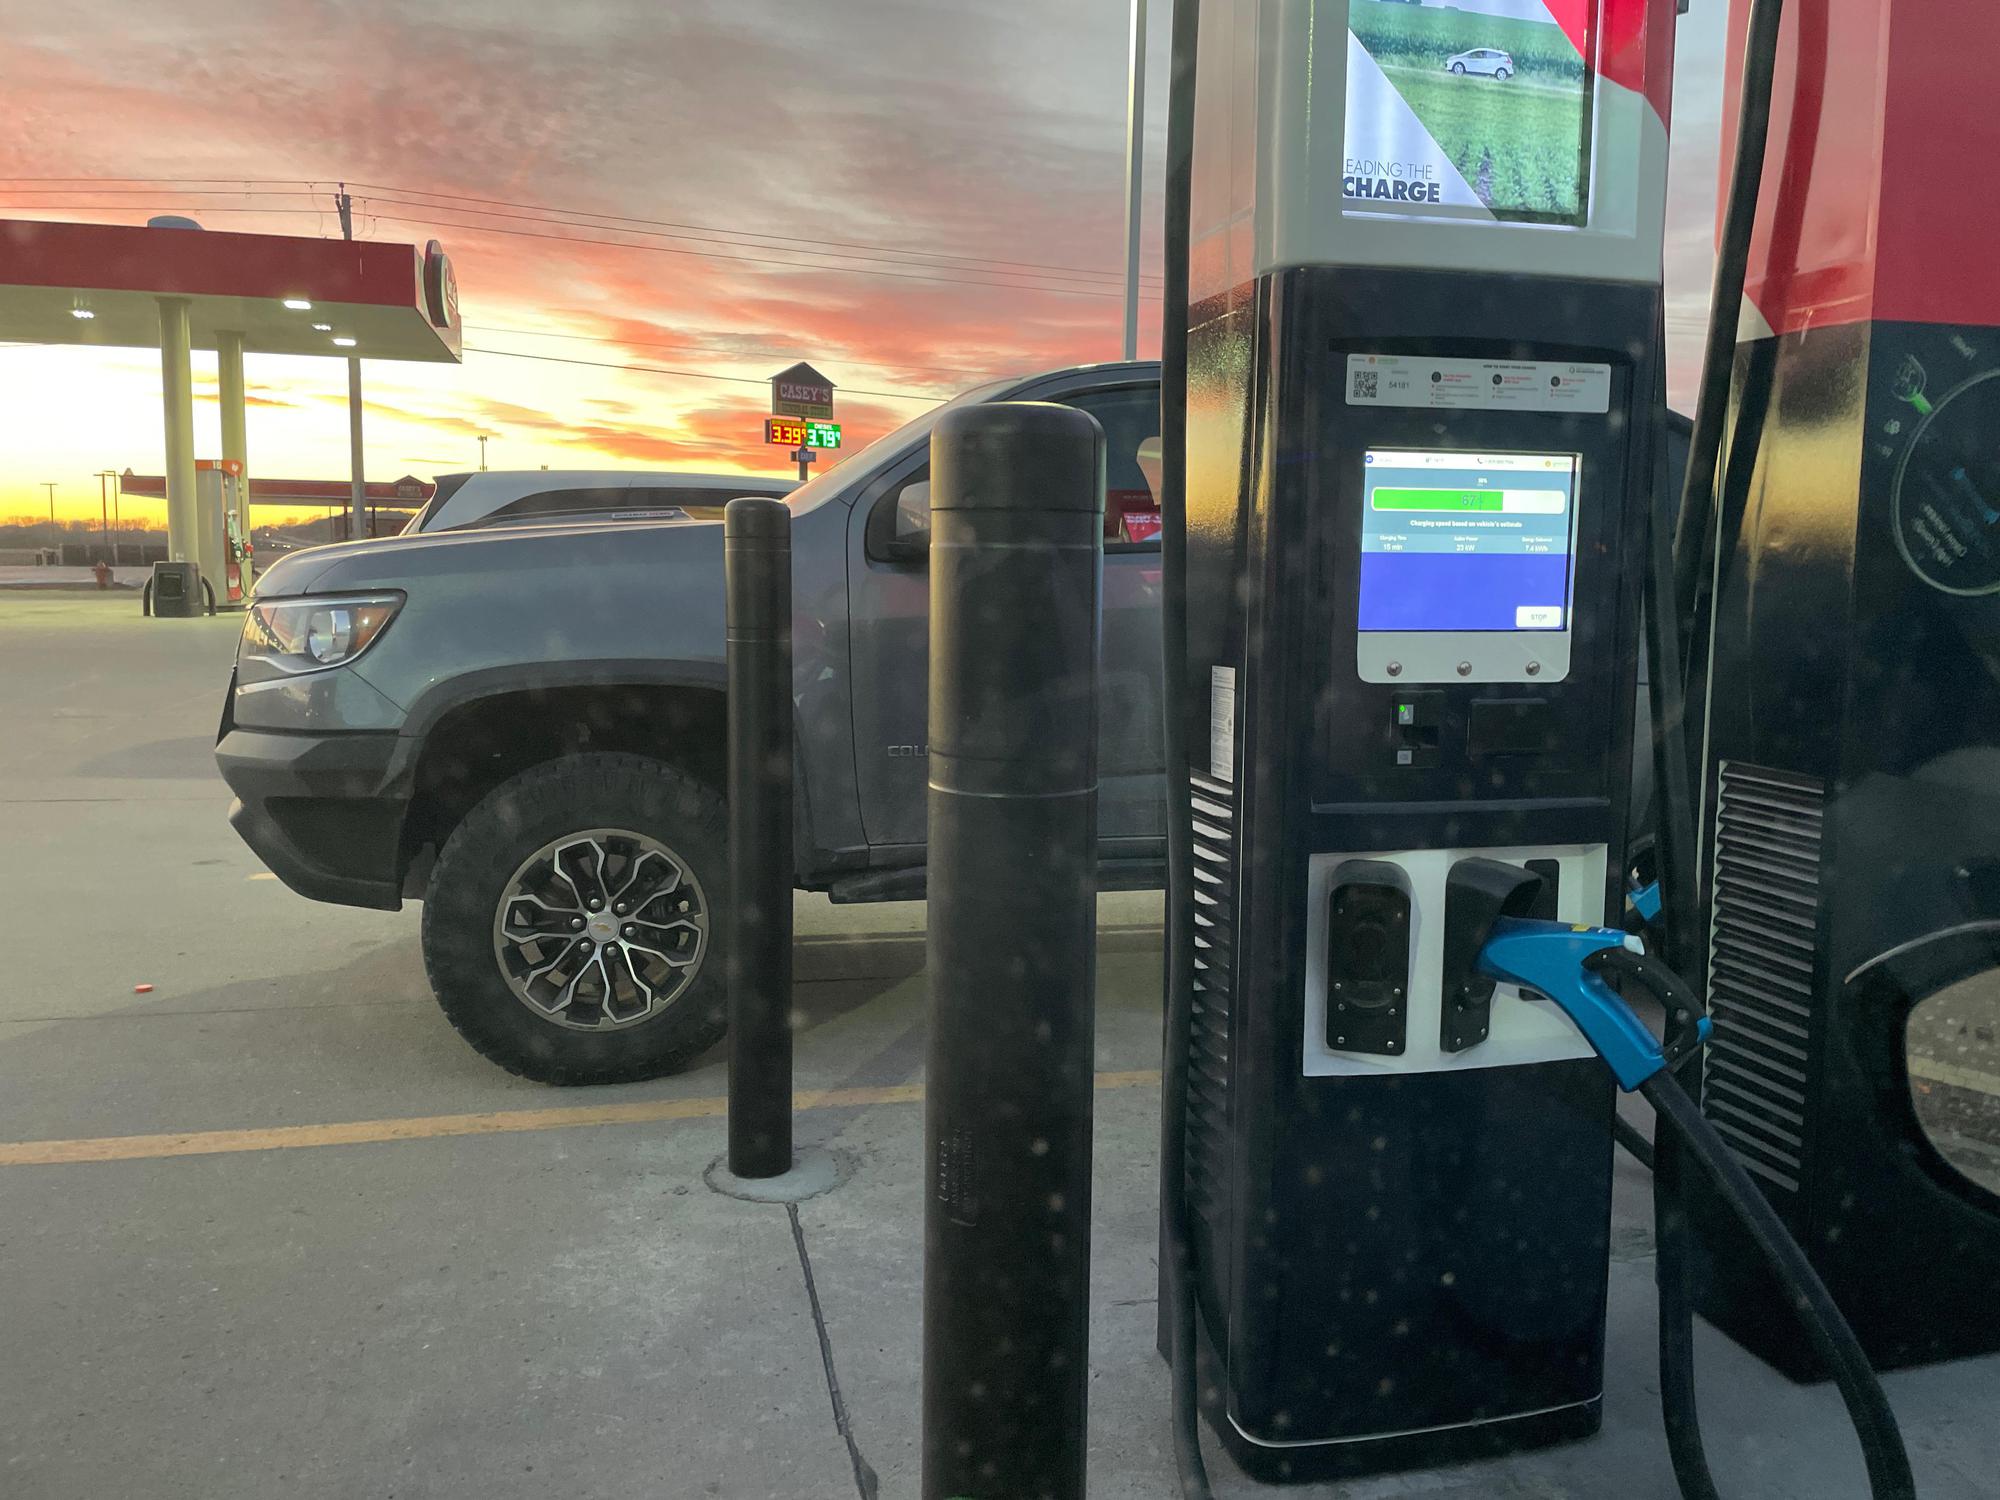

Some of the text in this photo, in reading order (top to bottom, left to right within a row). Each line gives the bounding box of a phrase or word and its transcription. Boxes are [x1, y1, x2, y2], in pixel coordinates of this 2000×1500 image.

[1344, 158, 1433, 180] EADING THE
[1343, 176, 1440, 203] CHARGE
[780, 384, 830, 402] CASEY'S
[1410, 519, 1435, 528] Charging
[887, 745, 929, 757] COL
